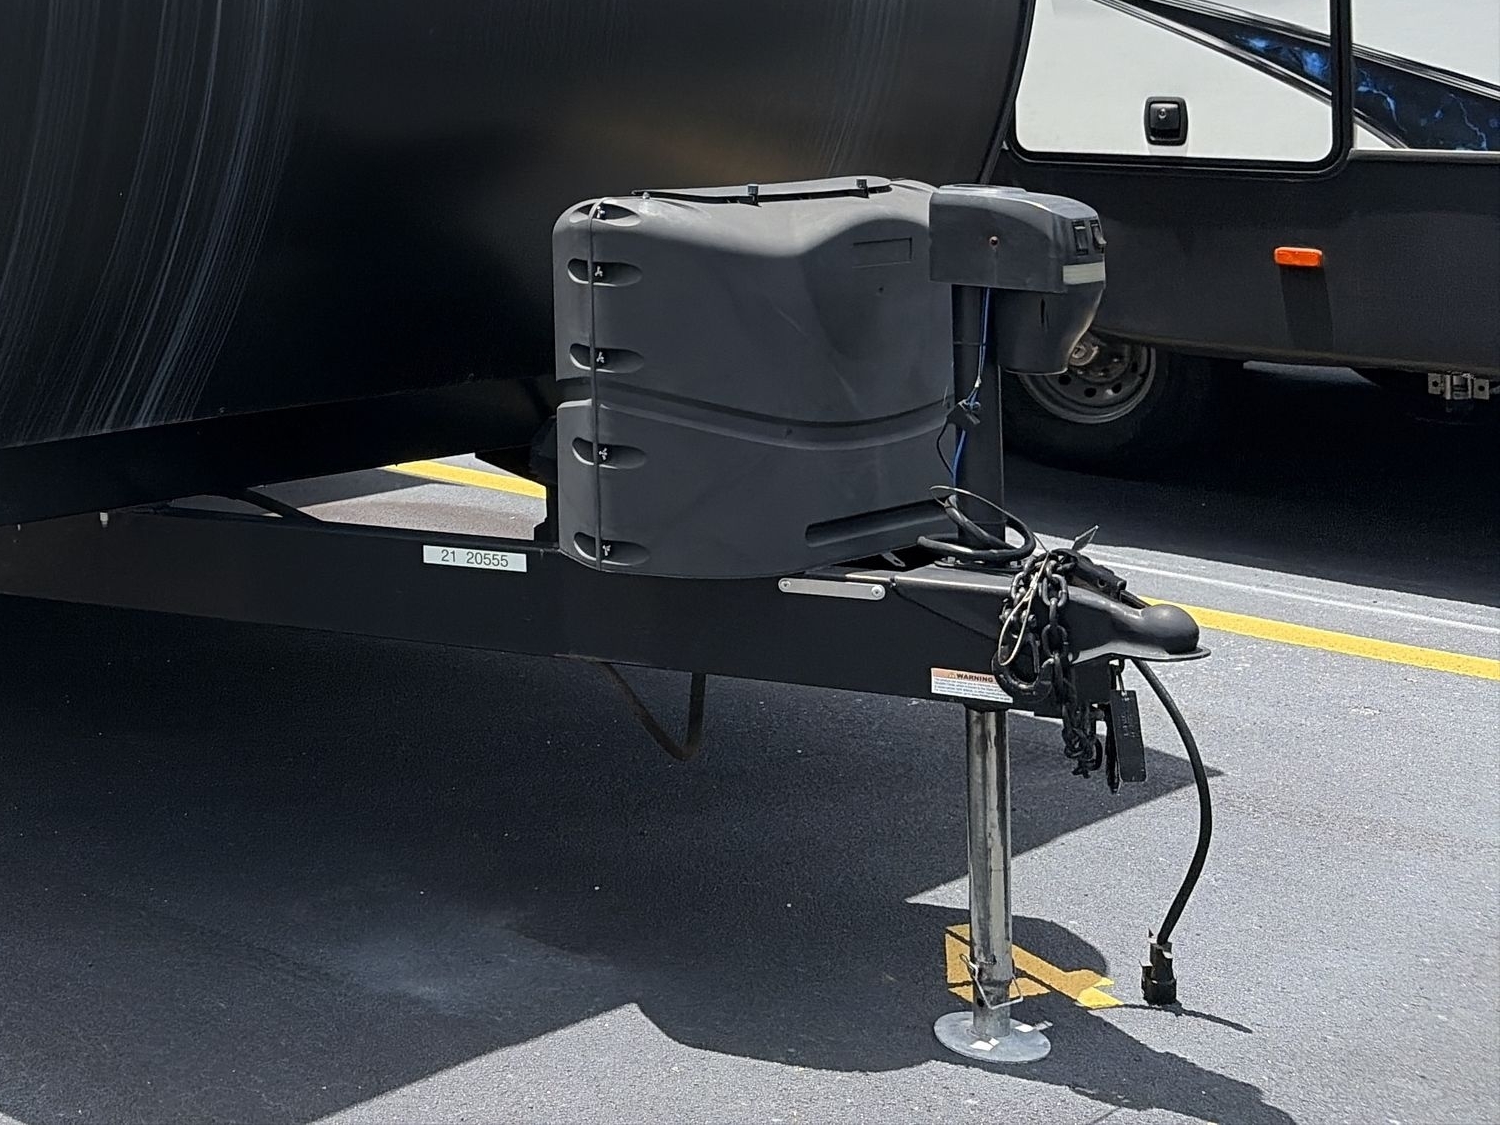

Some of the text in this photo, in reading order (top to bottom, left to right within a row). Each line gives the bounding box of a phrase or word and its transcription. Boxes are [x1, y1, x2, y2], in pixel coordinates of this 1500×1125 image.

[441, 549, 509, 567] 21 20555
[957, 673, 994, 683] WARNING
